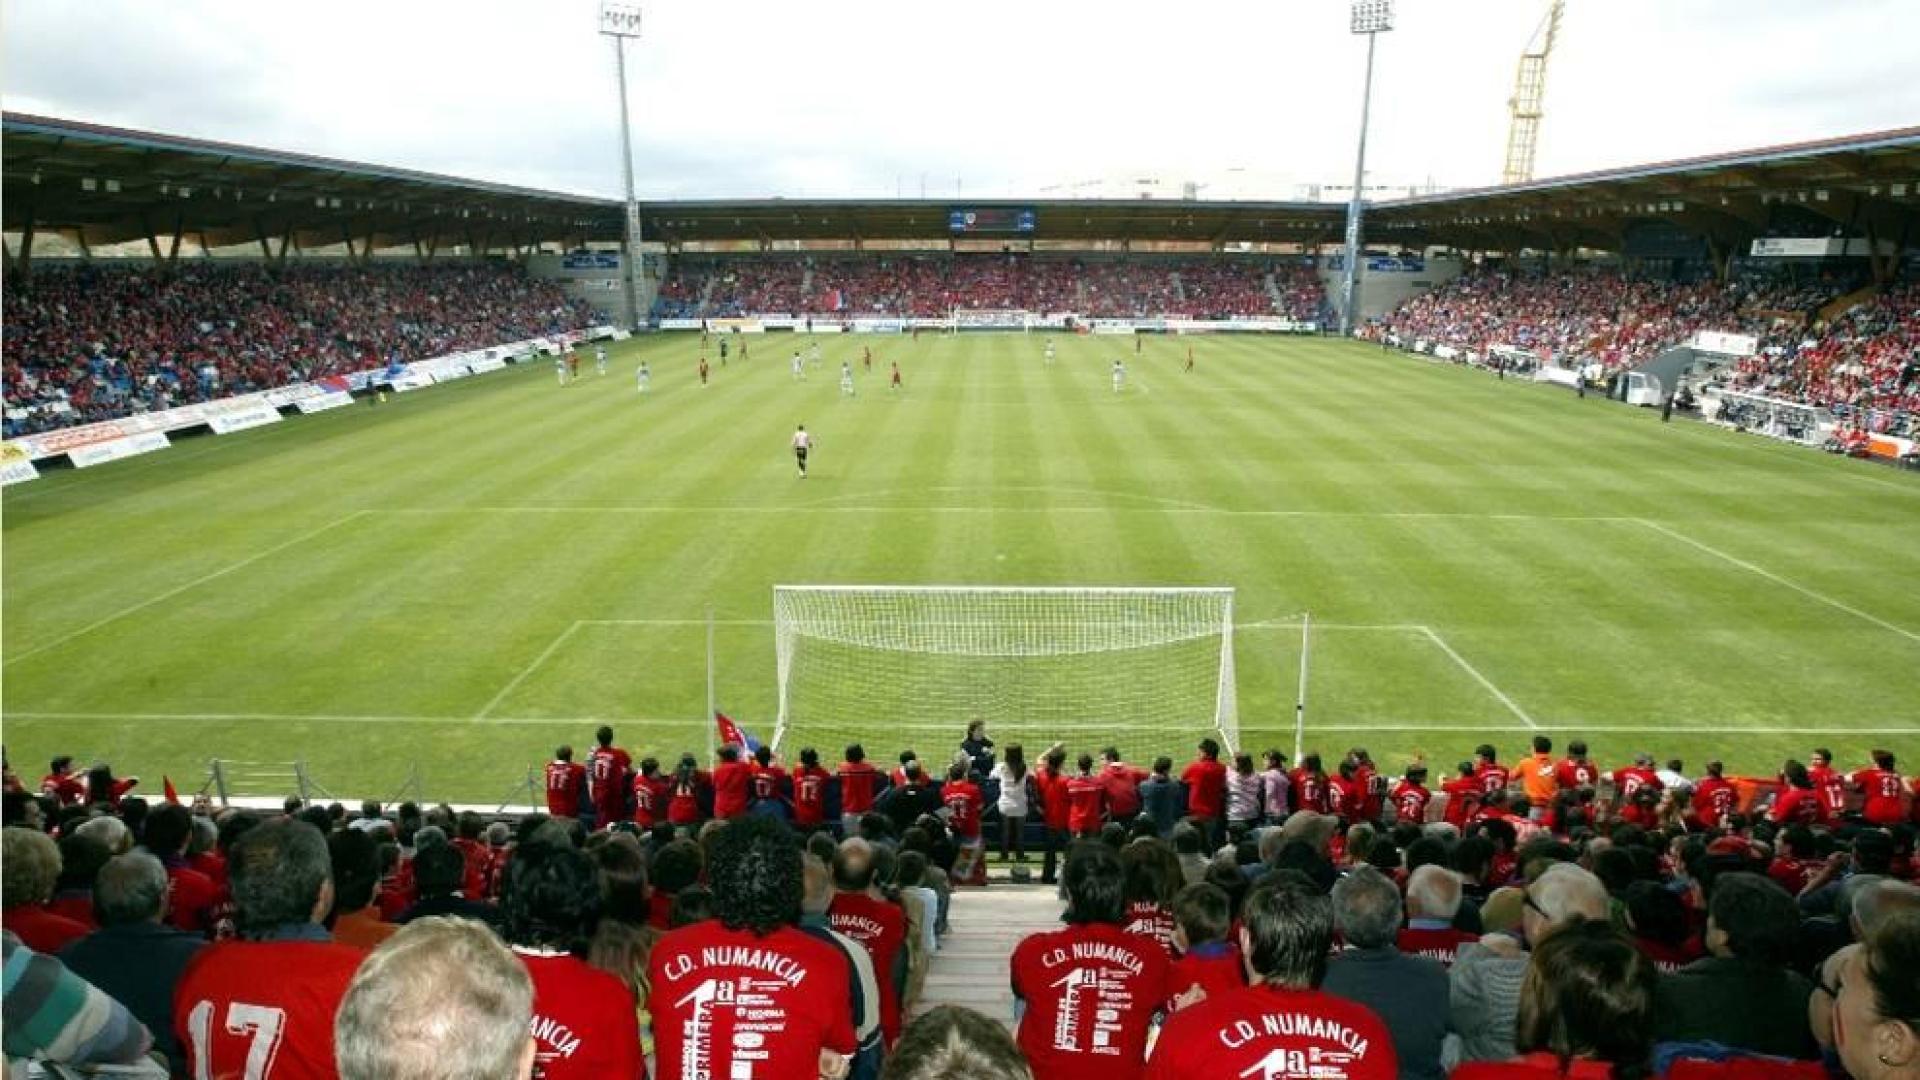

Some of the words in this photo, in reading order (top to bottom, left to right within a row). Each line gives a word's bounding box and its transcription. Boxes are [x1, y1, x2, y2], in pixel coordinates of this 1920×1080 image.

[831, 914, 884, 937] UMANCIA
[702, 946, 807, 988] NUMANCIA
[1072, 943, 1144, 976] NUMANCIA
[188, 1000, 286, 1080] 17
[531, 1014, 581, 1059] ANCIA
[1262, 1014, 1368, 1060] NUMANCIA
